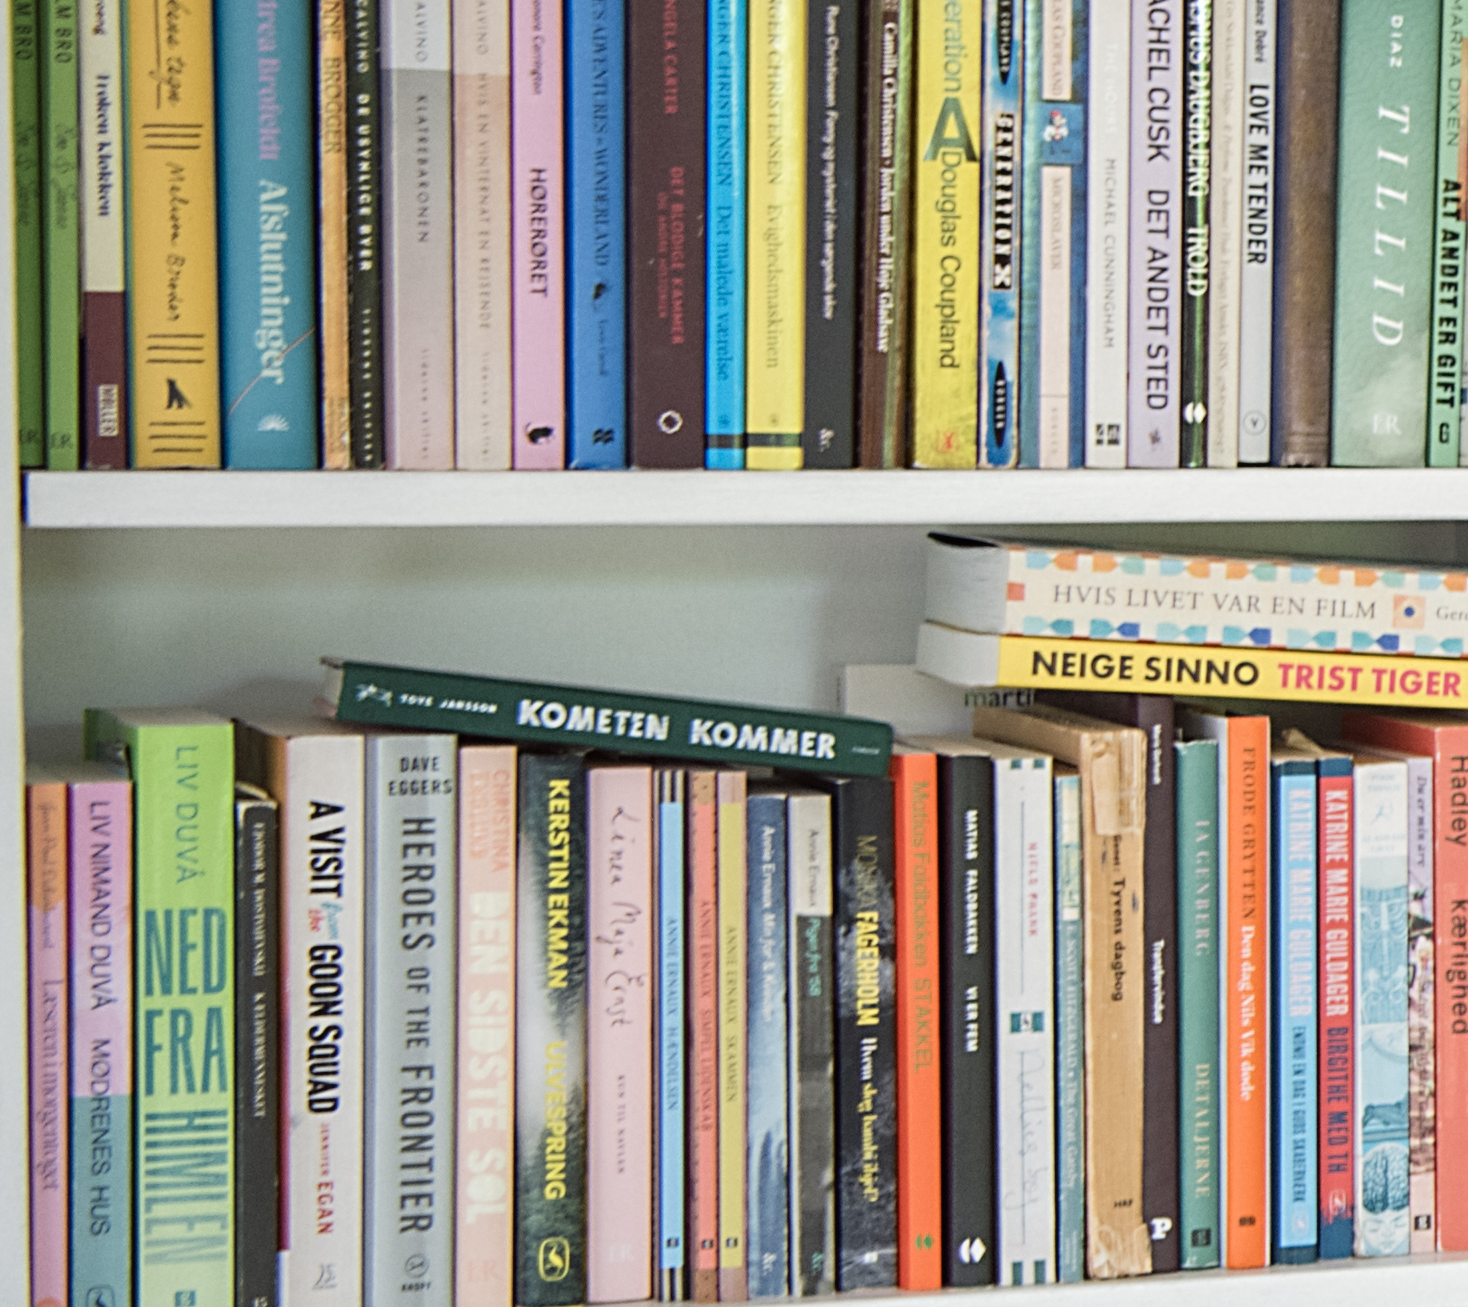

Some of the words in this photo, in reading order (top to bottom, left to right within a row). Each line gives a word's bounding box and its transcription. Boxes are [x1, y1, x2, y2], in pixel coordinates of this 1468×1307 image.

[924, 97, 979, 162] A
[1147, 86, 1168, 163] CUSK
[1250, 84, 1269, 138] LOVE
[935, 152, 961, 247] Douglas
[1250, 144, 1269, 173] ME
[1147, 187, 1168, 236] DET
[1248, 179, 1268, 266] TENDER
[1372, 104, 1413, 348] TILLID
[255, 178, 285, 385] Afslutninger
[936, 254, 961, 370] Coupland
[1147, 245, 1168, 331] ANDET
[1147, 340, 1168, 413] STED
[1052, 584, 1118, 607] HVIS
[1126, 588, 1202, 611] LIVET
[1211, 592, 1264, 615] VAR
[1271, 597, 1305, 616] EN
[1313, 599, 1376, 620] FILM
[1031, 650, 1139, 683] NEIGE
[1145, 656, 1259, 686] SINNO
[1278, 662, 1364, 693] TRIST
[1371, 666, 1462, 698] TIGER
[399, 756, 440, 772] DAVE
[517, 700, 669, 741] KOMETEN
[690, 718, 836, 761] KOMMER
[389, 778, 452, 795] EGGERS
[547, 780, 569, 886] KERSTIN
[401, 816, 435, 952] HEROES
[144, 906, 227, 998] NED
[405, 966, 431, 991] OF
[547, 893, 569, 990] EKMAN
[144, 1006, 227, 1096] FRA
[404, 1001, 431, 1048] THE
[399, 1065, 433, 1235] FRONTIER
[545, 1043, 565, 1200] ULVESPRING
[143, 1108, 229, 1265] HIMLEN
